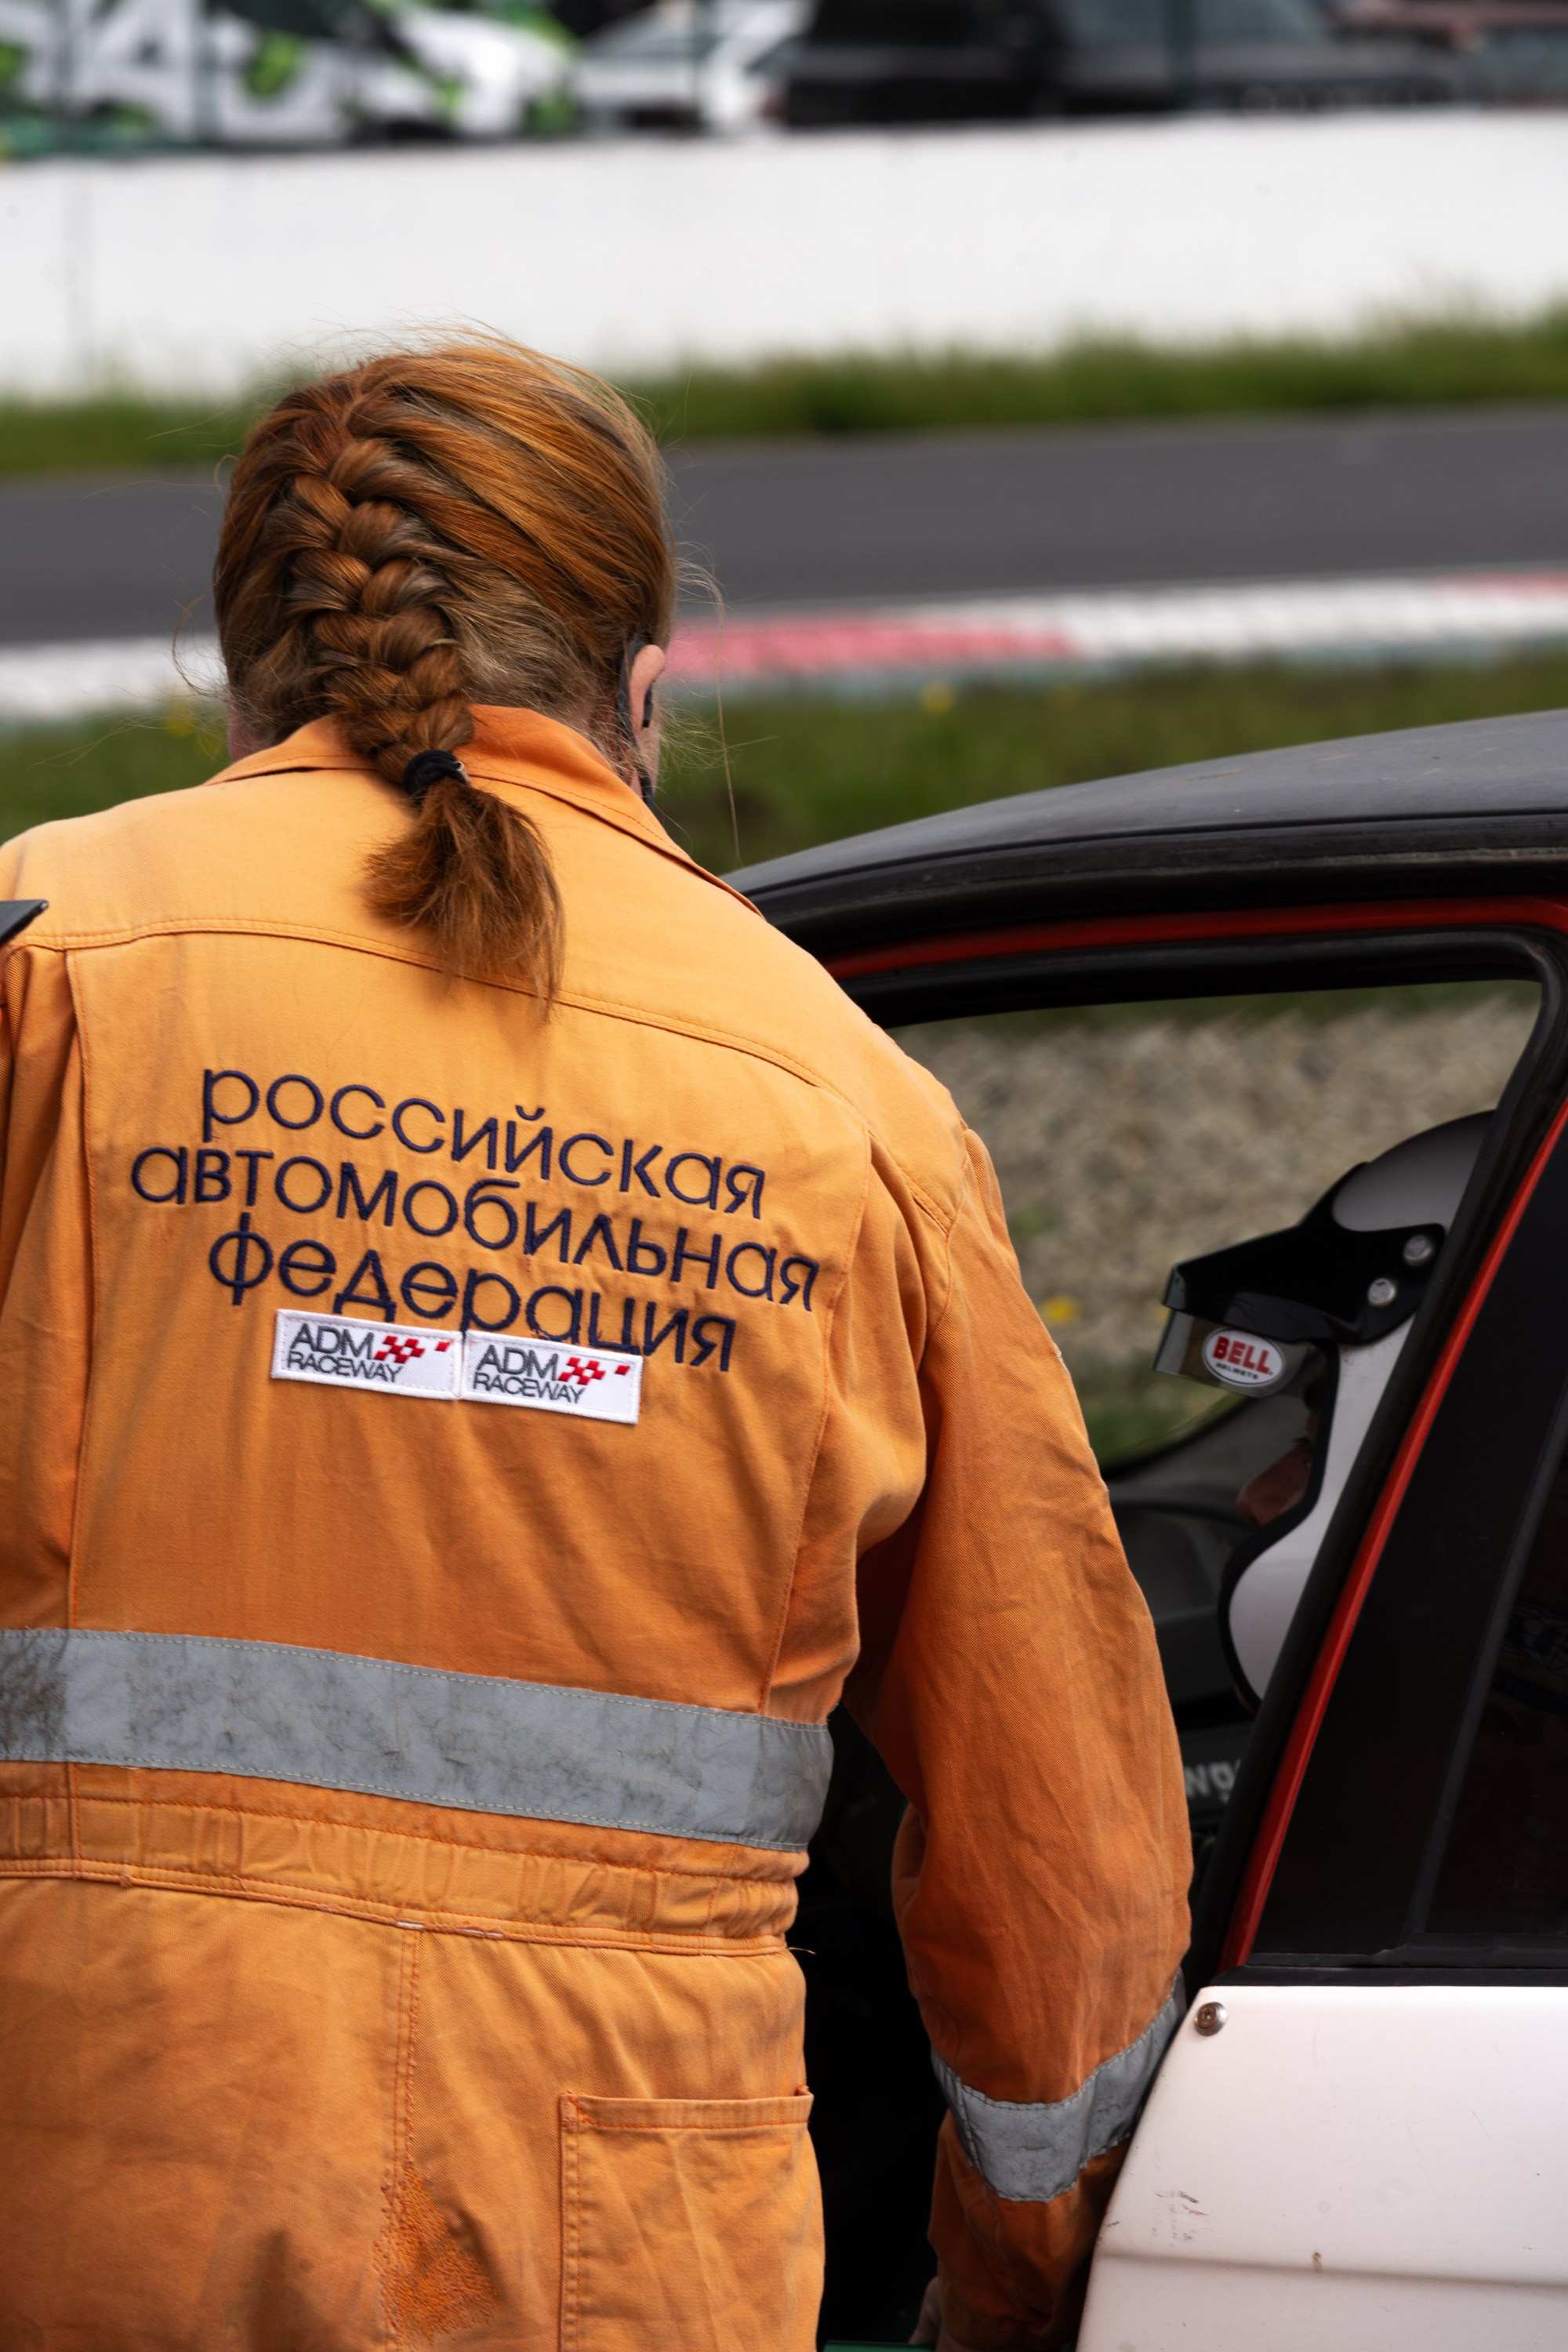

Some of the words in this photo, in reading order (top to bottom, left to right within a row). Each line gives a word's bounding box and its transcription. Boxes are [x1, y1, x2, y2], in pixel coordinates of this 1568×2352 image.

[202, 1068, 765, 1219] российская
[132, 1146, 819, 1312] автомобильная
[209, 1211, 736, 1371] федерация
[290, 1323, 375, 1360] ADM
[1212, 1335, 1270, 1376] BELL
[287, 1350, 405, 1383] RACEWAY
[476, 1344, 559, 1381] ADM
[1215, 1362, 1258, 1380] HELMETS
[473, 1371, 586, 1404] RACEWAY
